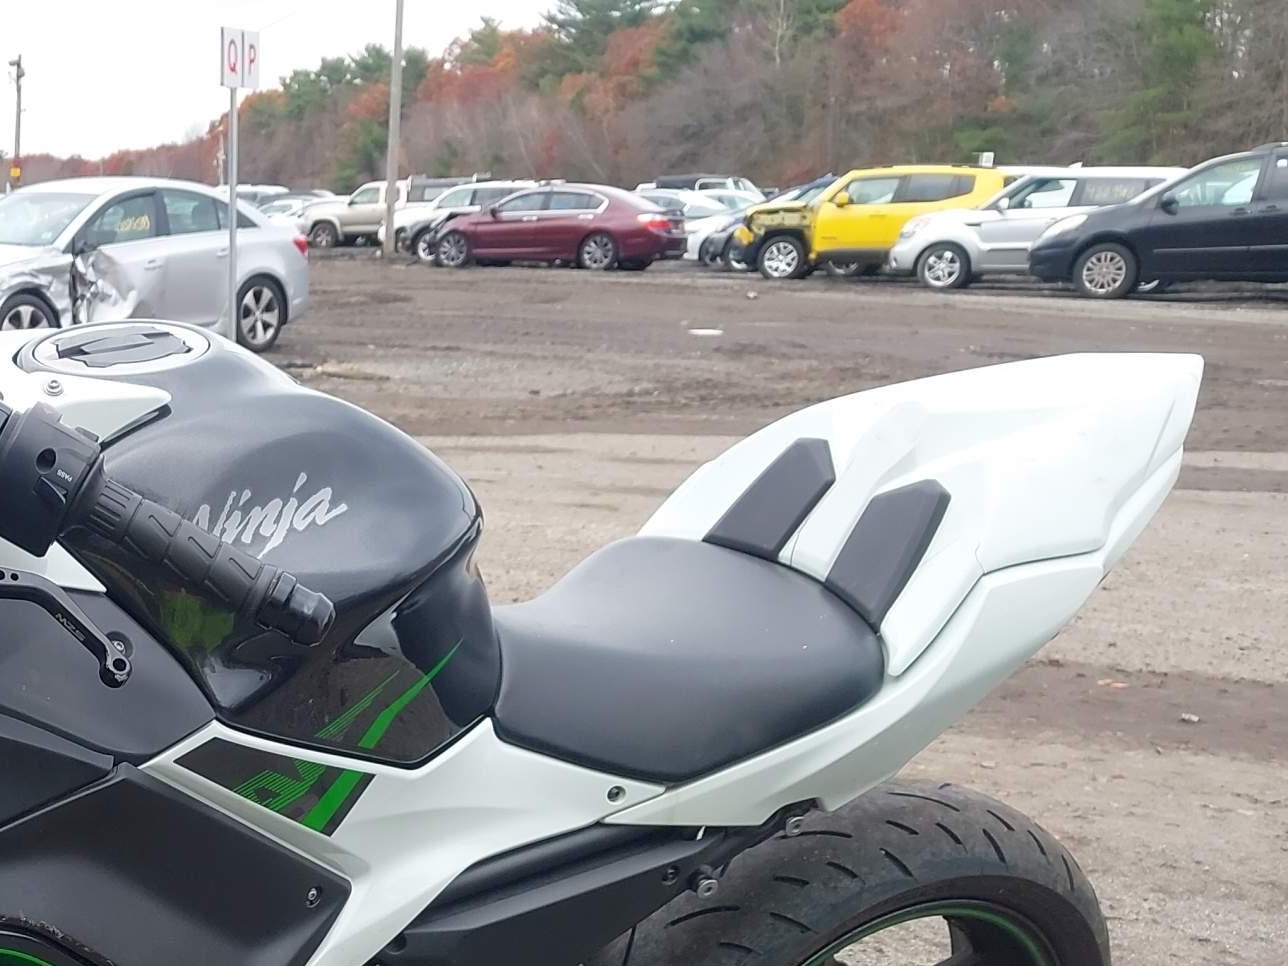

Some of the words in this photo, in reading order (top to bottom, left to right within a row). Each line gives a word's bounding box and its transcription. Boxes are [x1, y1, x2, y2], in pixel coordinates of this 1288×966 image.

[227, 38, 238, 75] Q
[248, 43, 257, 76] P
[56, 469, 73, 483] PASS
[193, 471, 349, 560] Ninja
